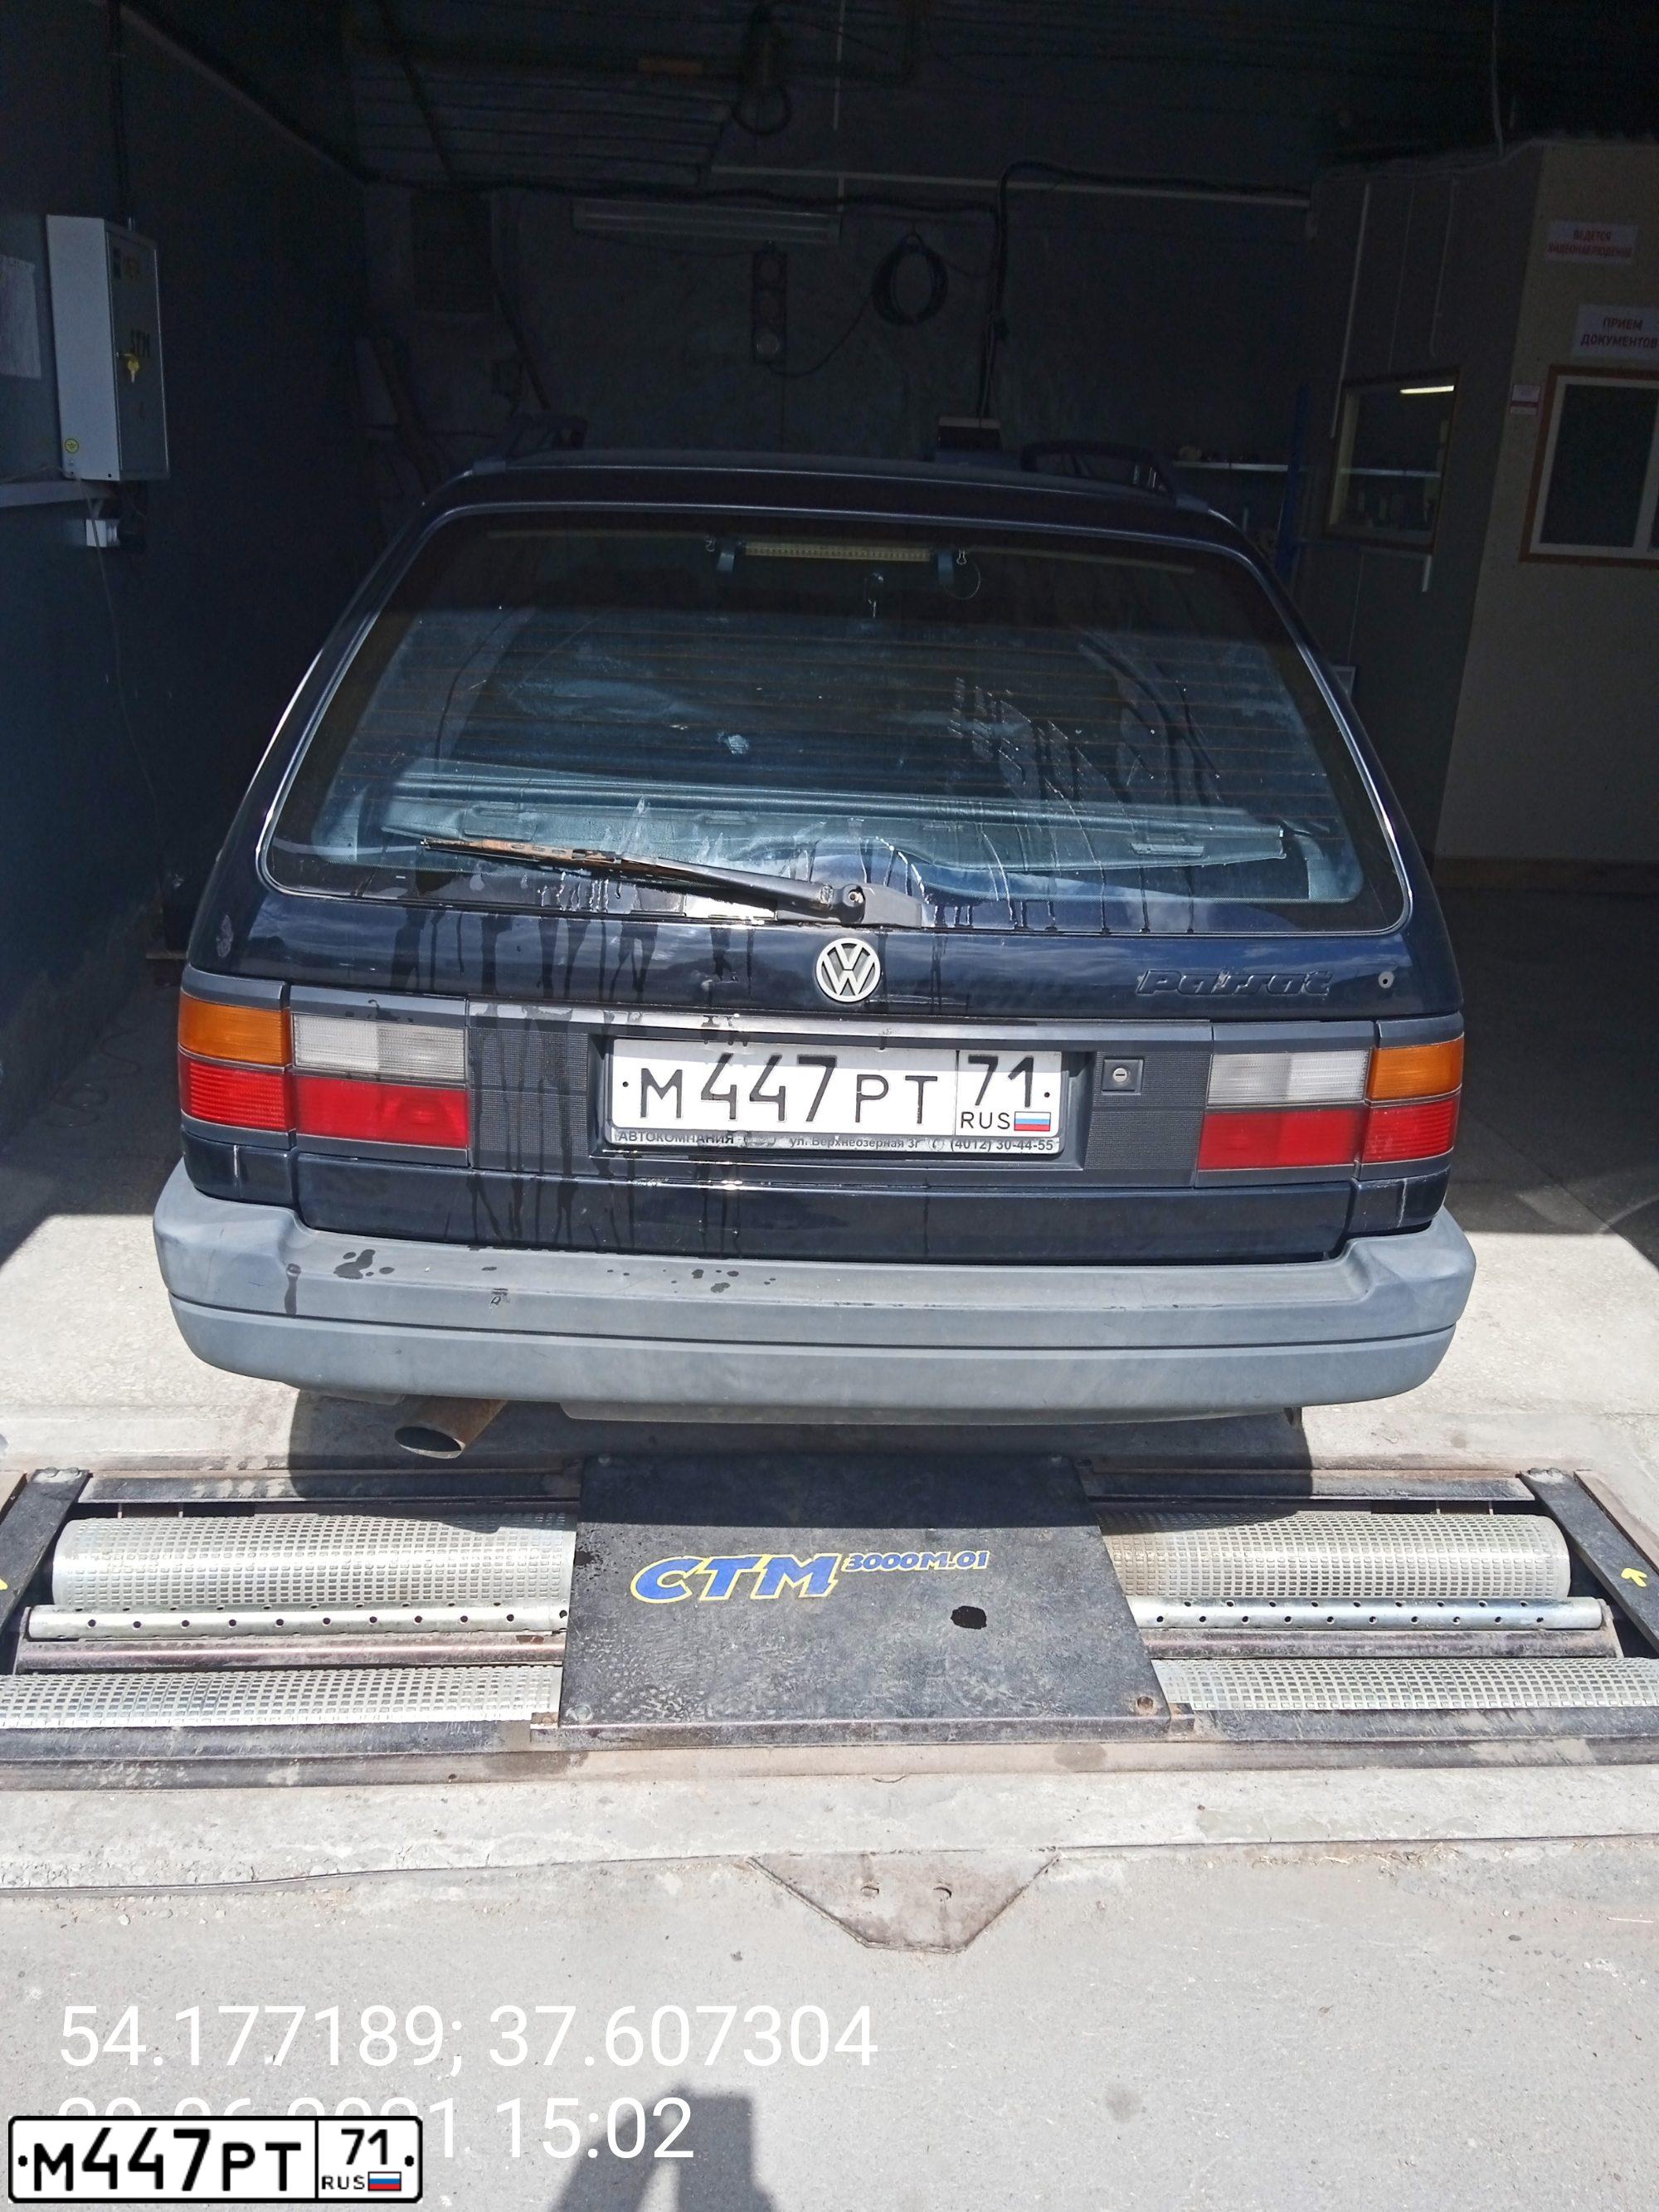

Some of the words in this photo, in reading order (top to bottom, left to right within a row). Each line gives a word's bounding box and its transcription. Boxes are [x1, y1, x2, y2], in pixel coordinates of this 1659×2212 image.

[1603, 317, 1643, 331] ПРИЕМ
[1580, 334, 1659, 348] ДОКУМЕНТОВ
[967, 1056, 1035, 1108] 71
[960, 1111, 1010, 1130] RUS
[618, 1131, 734, 1144] АВТОКОМПАНИЯ
[789, 1138, 808, 1147] ул.
[950, 1138, 992, 1152] (4012)
[996, 1140, 1053, 1151] 30-44-55
